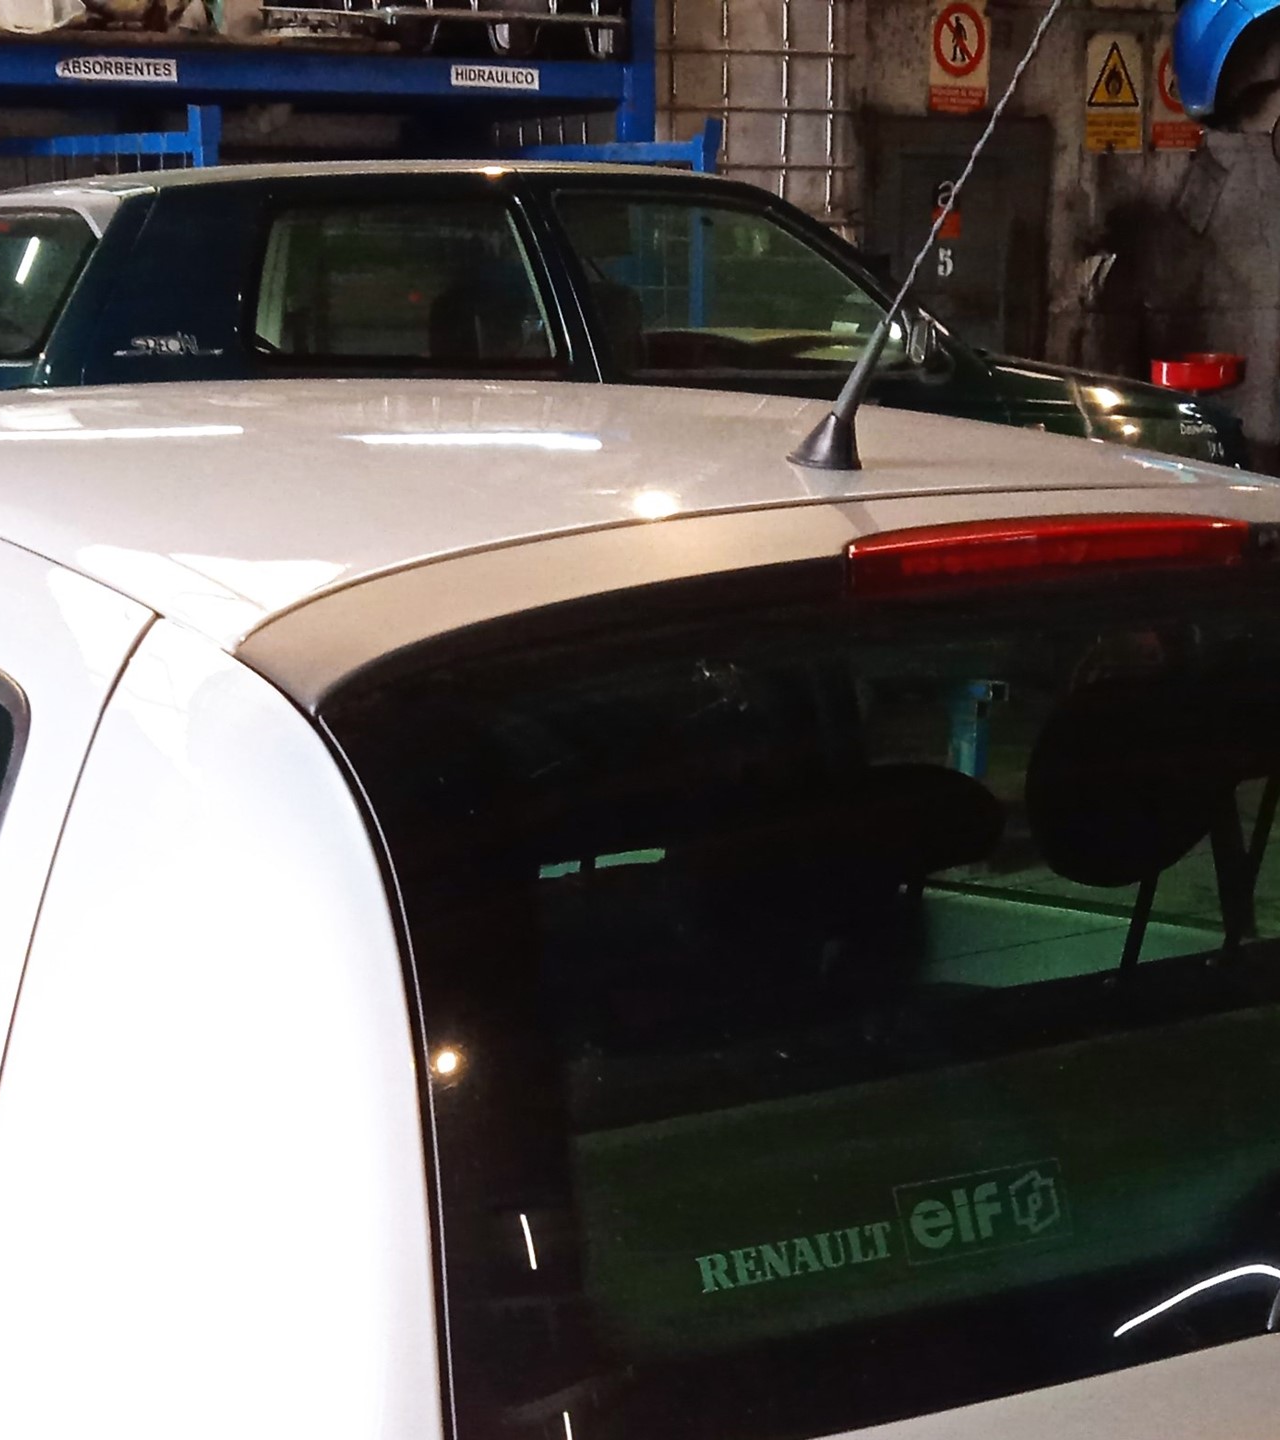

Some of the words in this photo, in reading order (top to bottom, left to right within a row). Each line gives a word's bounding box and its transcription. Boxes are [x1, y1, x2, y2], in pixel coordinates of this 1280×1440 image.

[61, 60, 173, 77] ABSORBENTES
[454, 67, 535, 85] HIDRAULICO
[936, 247, 954, 277] 5
[694, 1220, 893, 1295] RENAULT
[909, 1181, 1003, 1250] elf
